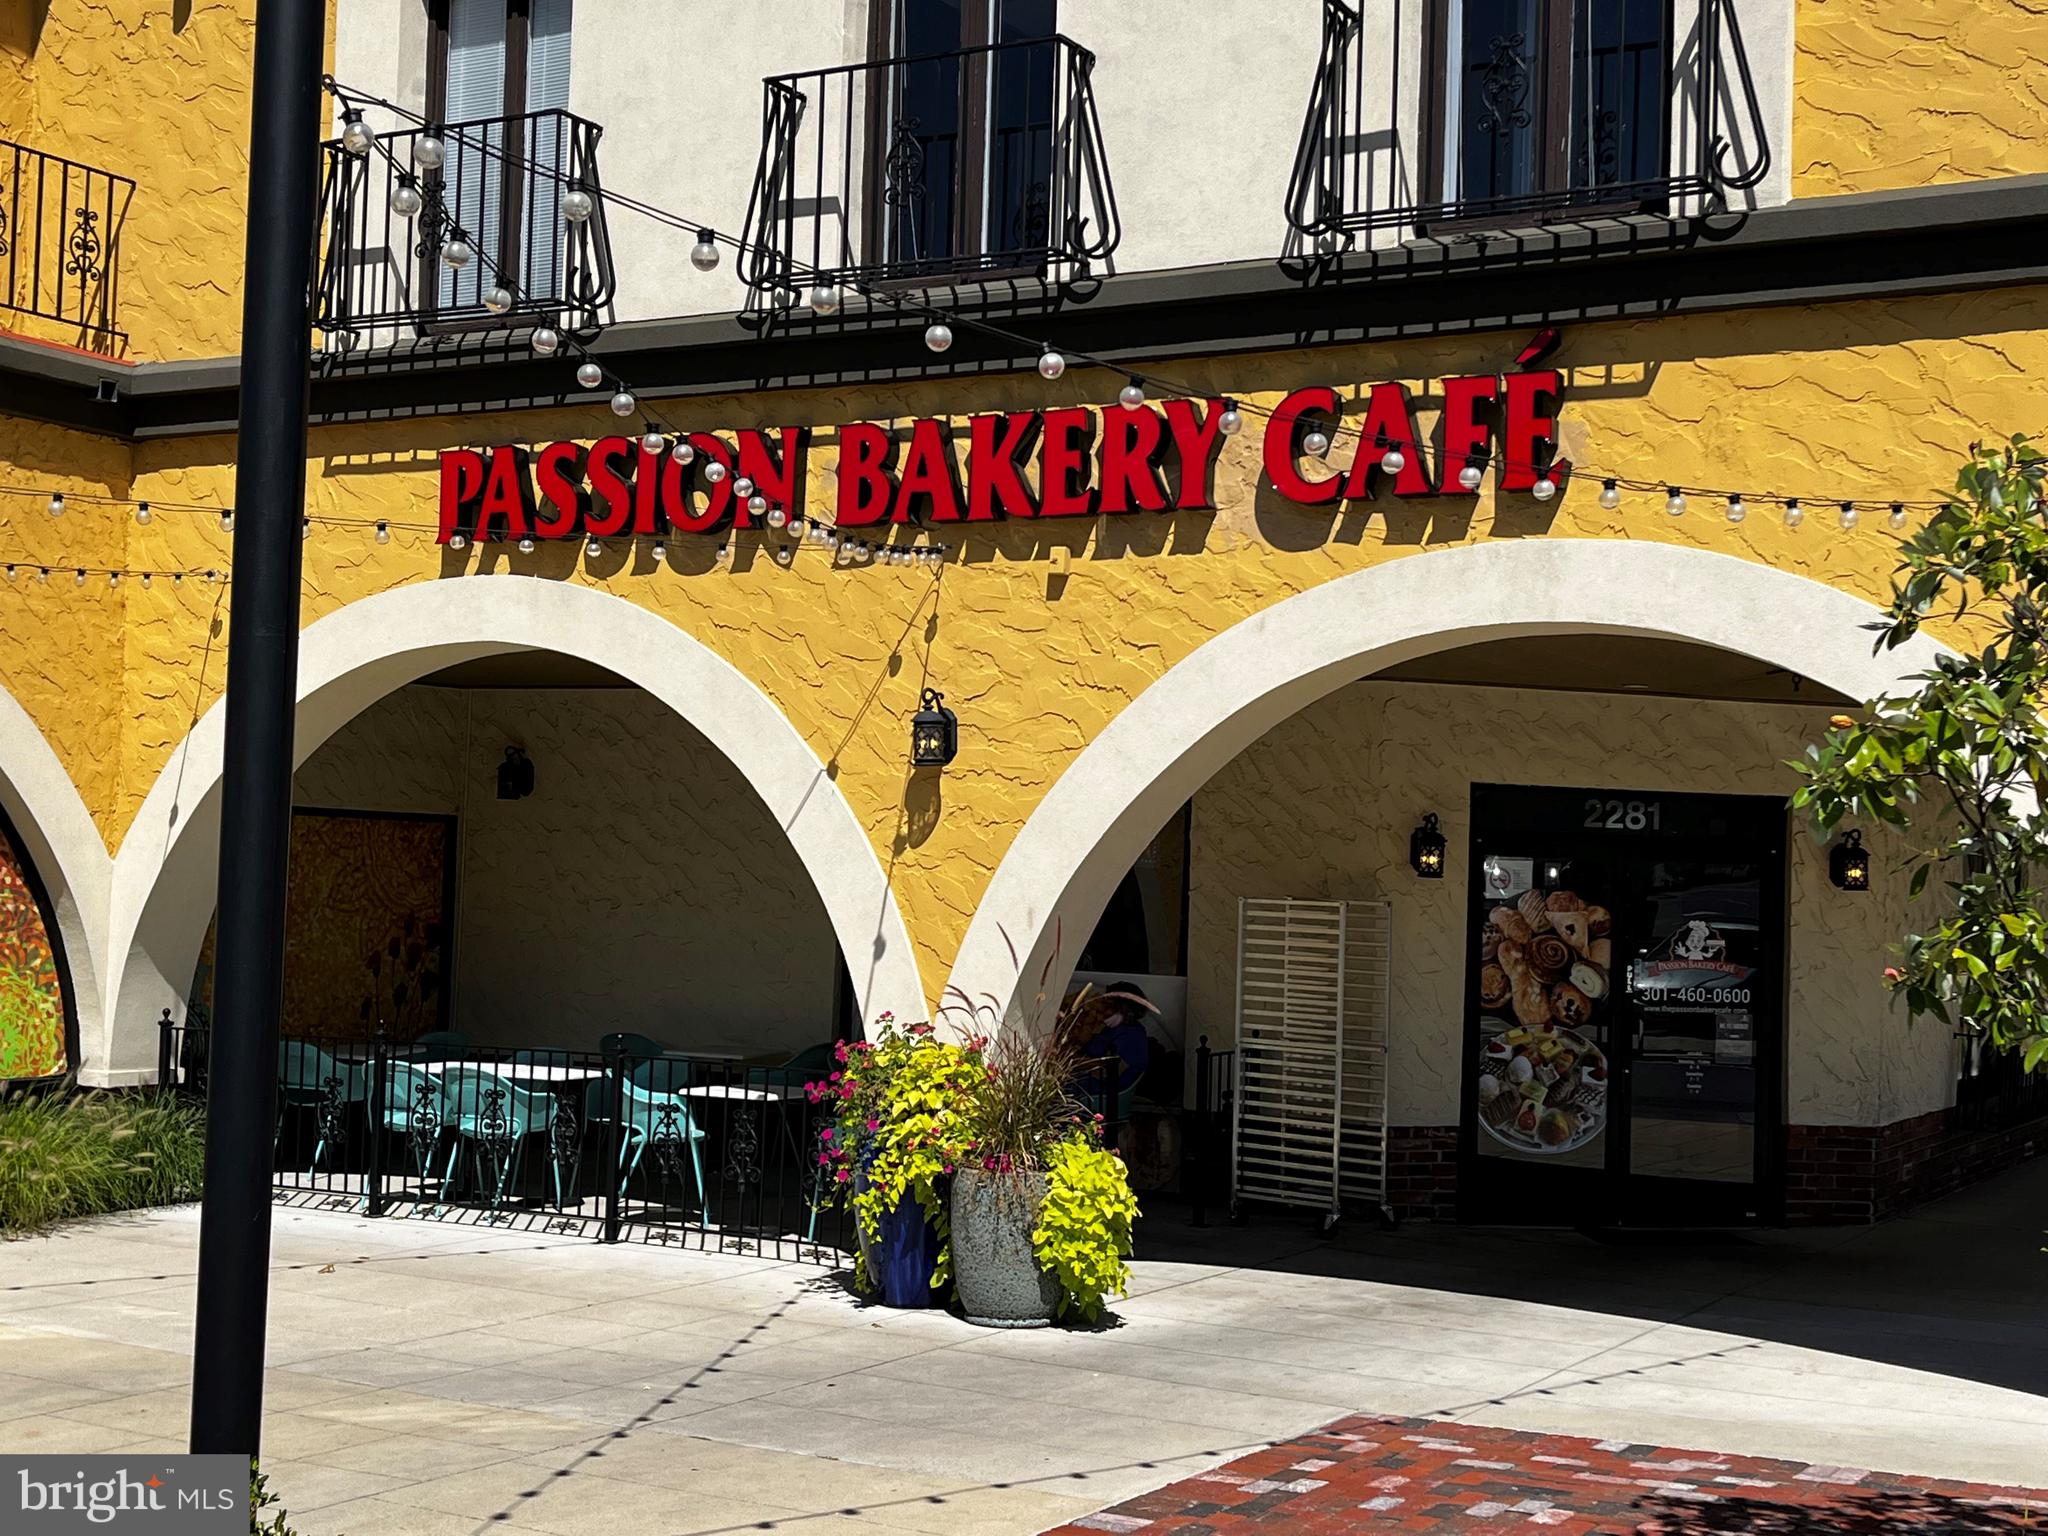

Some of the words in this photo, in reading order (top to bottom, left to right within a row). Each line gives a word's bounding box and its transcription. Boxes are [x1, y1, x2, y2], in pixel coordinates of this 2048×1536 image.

[437, 427, 810, 545] PASSION
[836, 400, 1226, 524] BAKERY
[1262, 327, 1566, 504] CAFÉ
[1584, 798, 1661, 830] 2281
[1641, 988, 1751, 1003] 301-460-0600
